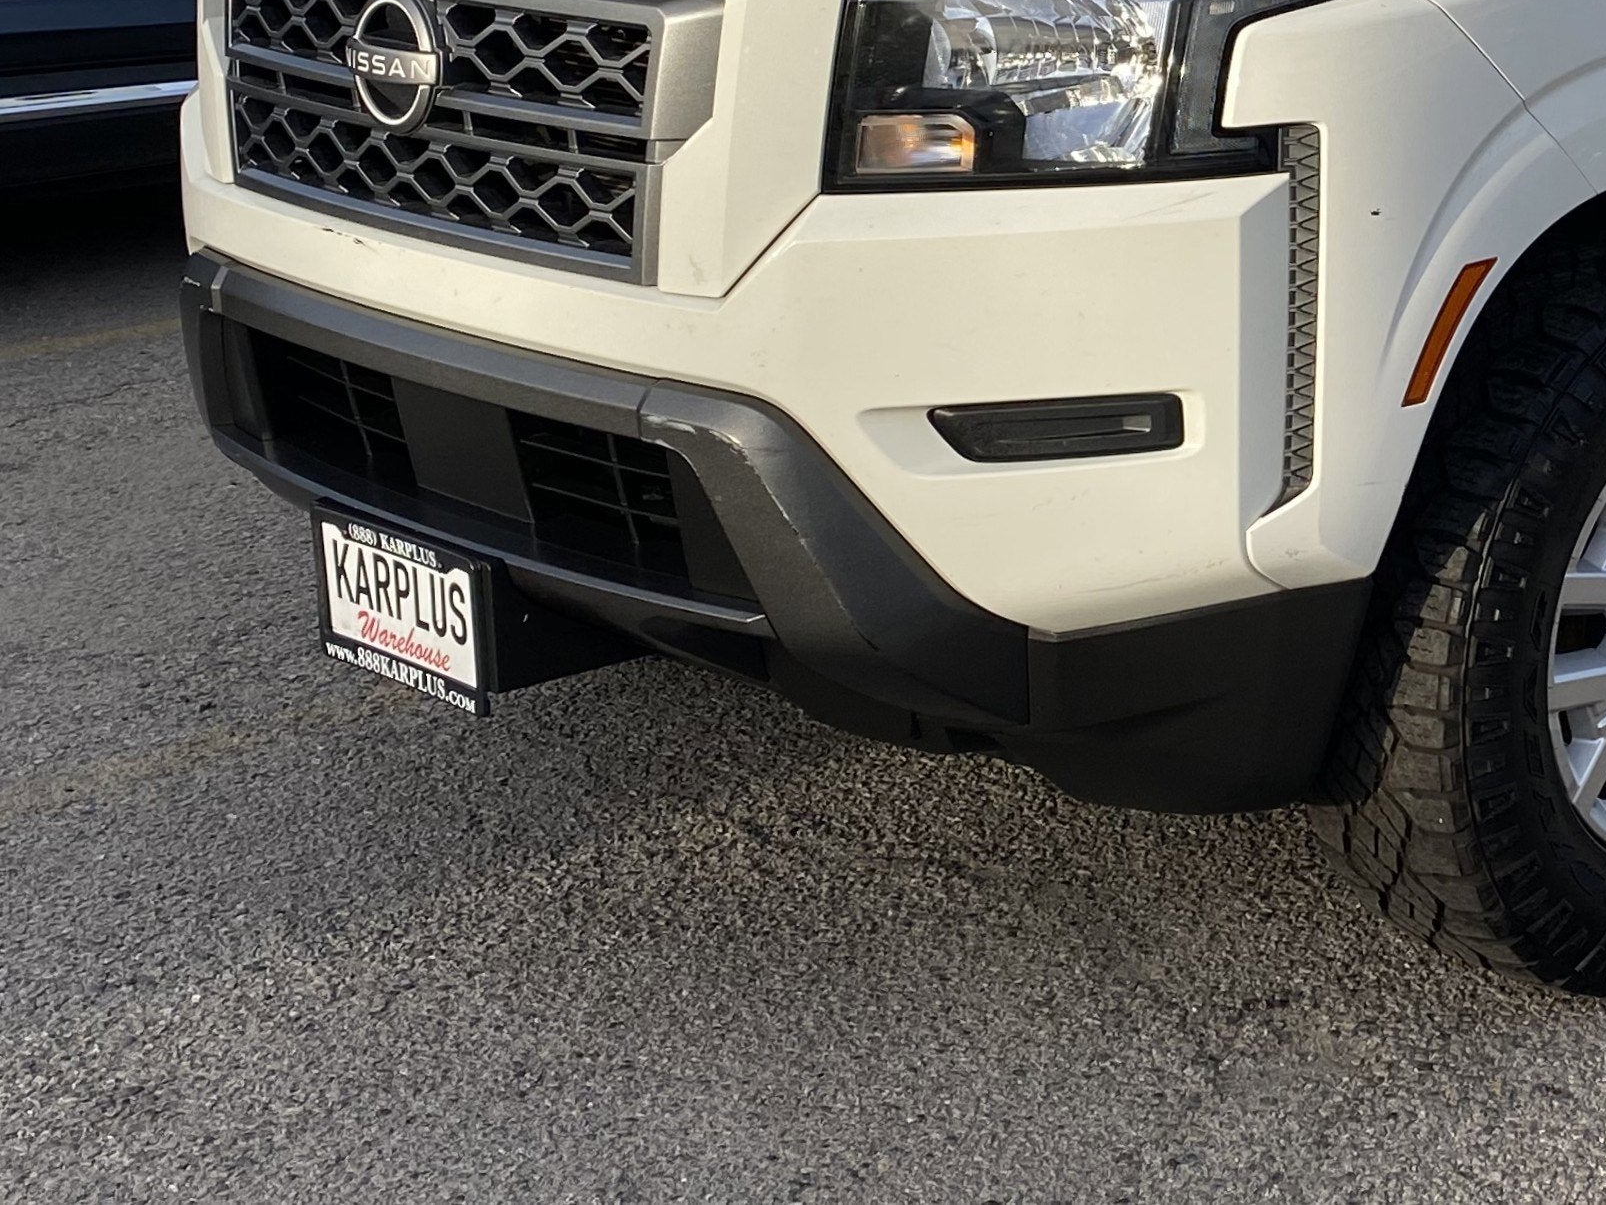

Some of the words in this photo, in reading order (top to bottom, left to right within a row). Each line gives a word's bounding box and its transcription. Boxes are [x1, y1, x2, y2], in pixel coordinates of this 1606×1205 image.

[345, 45, 432, 79] NISSAN
[348, 522, 377, 546] (888)
[378, 532, 438, 569] KARPLUS
[331, 539, 469, 646] KARPLUS
[357, 609, 452, 673] Warehouse
